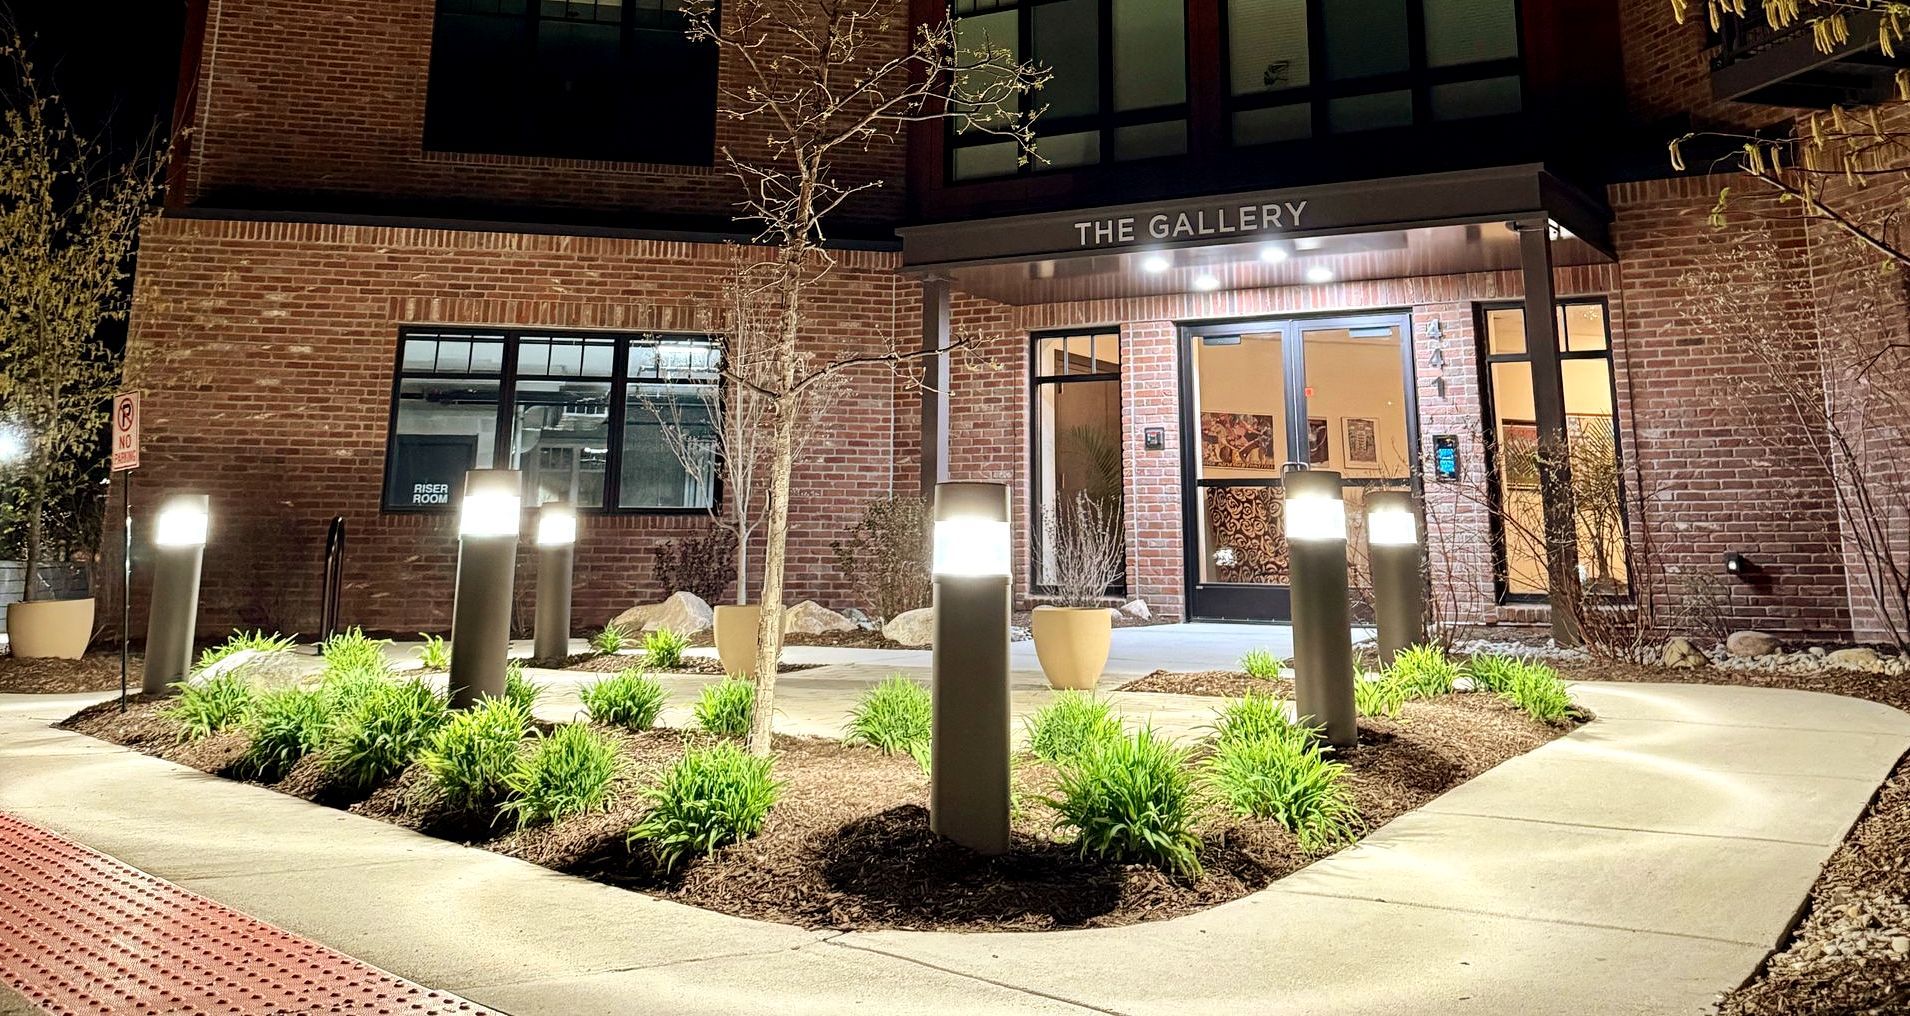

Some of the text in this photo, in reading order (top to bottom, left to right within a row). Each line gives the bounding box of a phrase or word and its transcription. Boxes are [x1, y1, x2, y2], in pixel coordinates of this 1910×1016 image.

[1074, 200, 1308, 246] THE GALLERY
[1426, 318, 1446, 399] 441
[119, 434, 132, 449] NO
[413, 483, 449, 493] RISER
[412, 494, 448, 503] ROOM
